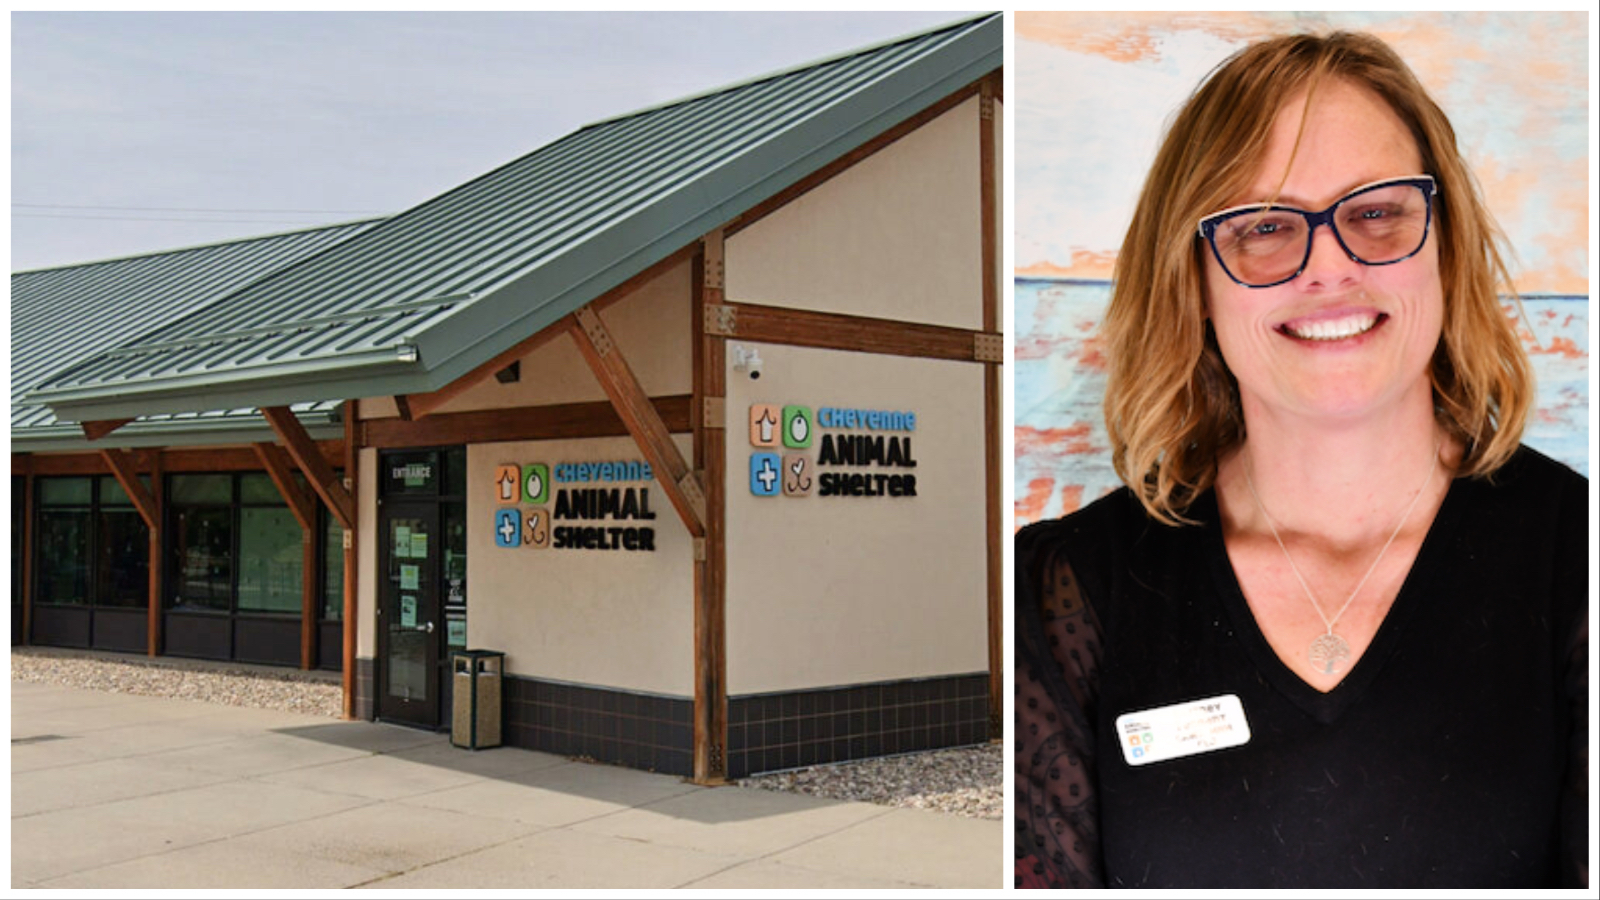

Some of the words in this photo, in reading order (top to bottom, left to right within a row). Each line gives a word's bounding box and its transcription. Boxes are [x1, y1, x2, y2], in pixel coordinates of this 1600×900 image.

[817, 433, 917, 467] ANIMAL
[392, 466, 431, 479] ENTRANCE
[553, 488, 656, 520] ANIMAL
